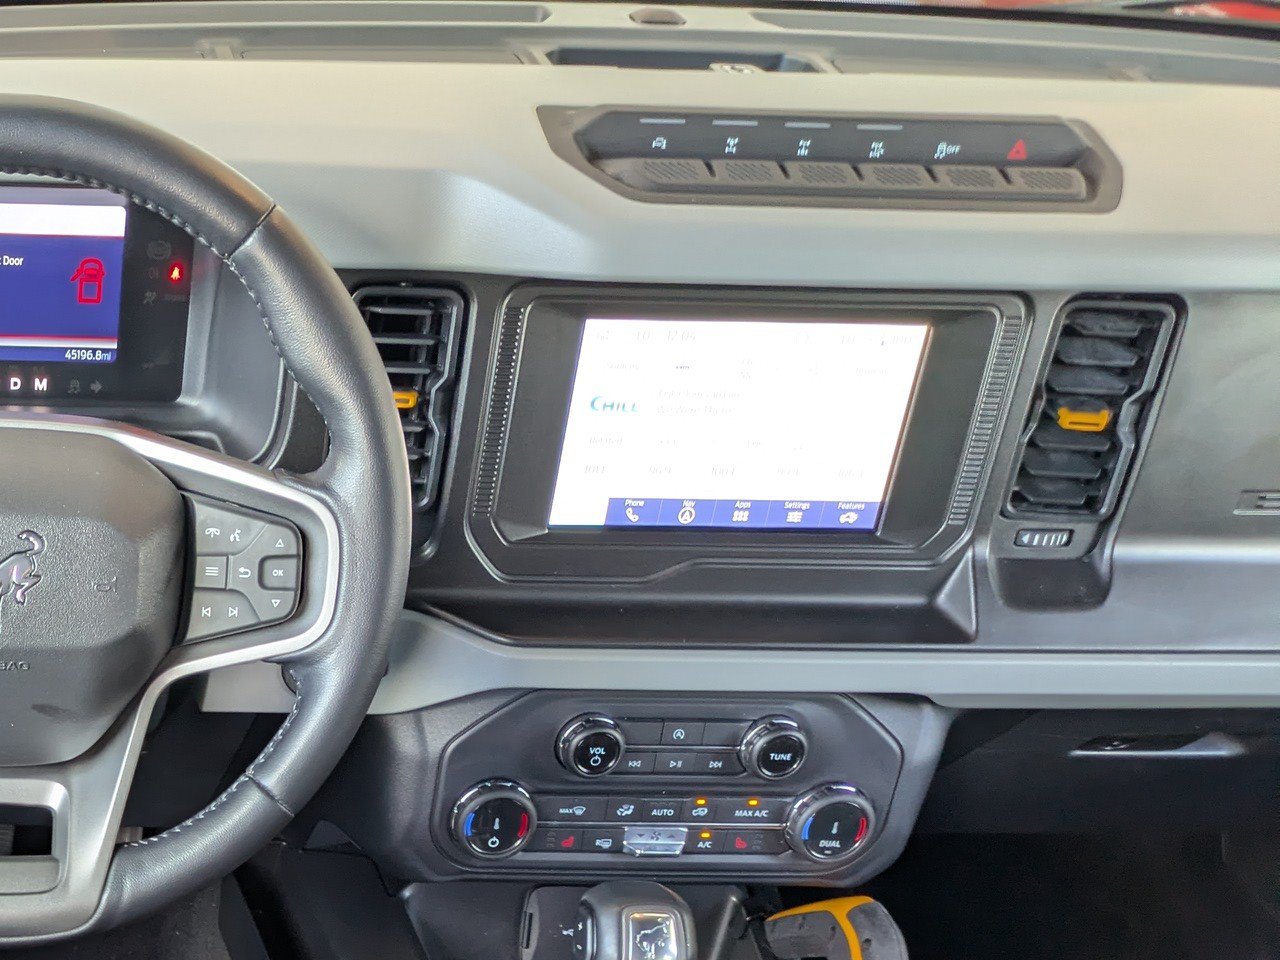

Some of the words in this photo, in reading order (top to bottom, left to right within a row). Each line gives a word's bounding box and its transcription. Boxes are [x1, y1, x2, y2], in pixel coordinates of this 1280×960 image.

[946, 144, 961, 155] OFF
[2, 256, 25, 266] Door
[9, 377, 22, 391] D
[34, 378, 48, 391] M
[624, 498, 645, 508] Phone
[683, 500, 696, 509] Nav
[734, 500, 752, 510] Apps
[783, 501, 811, 511] Settings
[837, 502, 866, 511] Features
[272, 569, 284, 577] OK
[589, 746, 606, 756] VOL
[769, 752, 793, 762] TUNE
[558, 807, 573, 815] MAX
[651, 808, 675, 817] AUTO
[734, 810, 753, 818] MAX
[753, 810, 769, 818] A/C
[697, 841, 713, 849] A/C
[818, 839, 842, 848] DUAL
